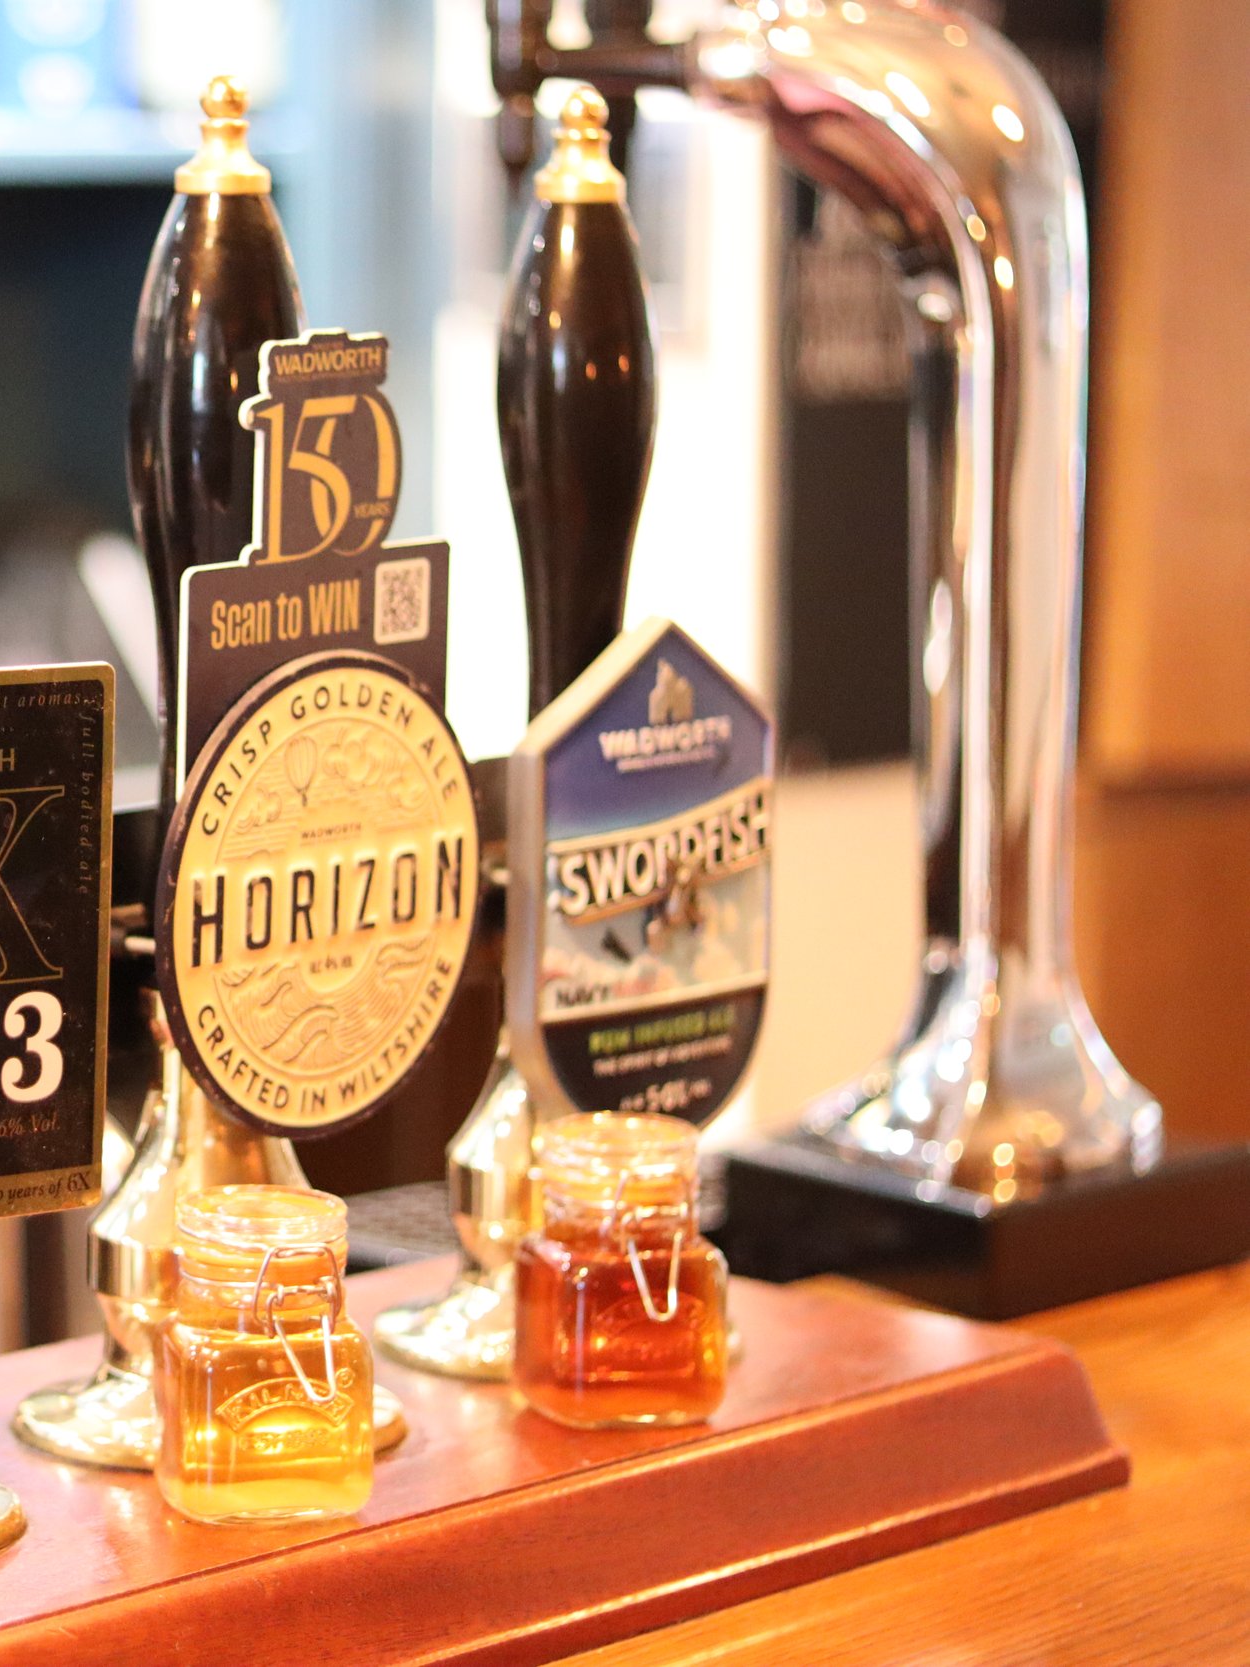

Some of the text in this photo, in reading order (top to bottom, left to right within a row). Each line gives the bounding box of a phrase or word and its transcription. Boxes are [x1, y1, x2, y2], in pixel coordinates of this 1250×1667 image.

[274, 346, 382, 376] WADWORTH
[211, 578, 362, 650] Scan to WIN
[78, 712, 96, 758] full
[202, 684, 457, 836] CRISP GOLDEN ALE
[79, 771, 95, 848] bodied
[191, 836, 465, 969] HORIZON
[197, 958, 452, 1115] CRAFTED IN WILTSHIRE
[30, 1111, 62, 1133] Vol.
[8, 1184, 45, 1206] years
[49, 1178, 63, 1197] of
[67, 1170, 91, 1192] 6X
